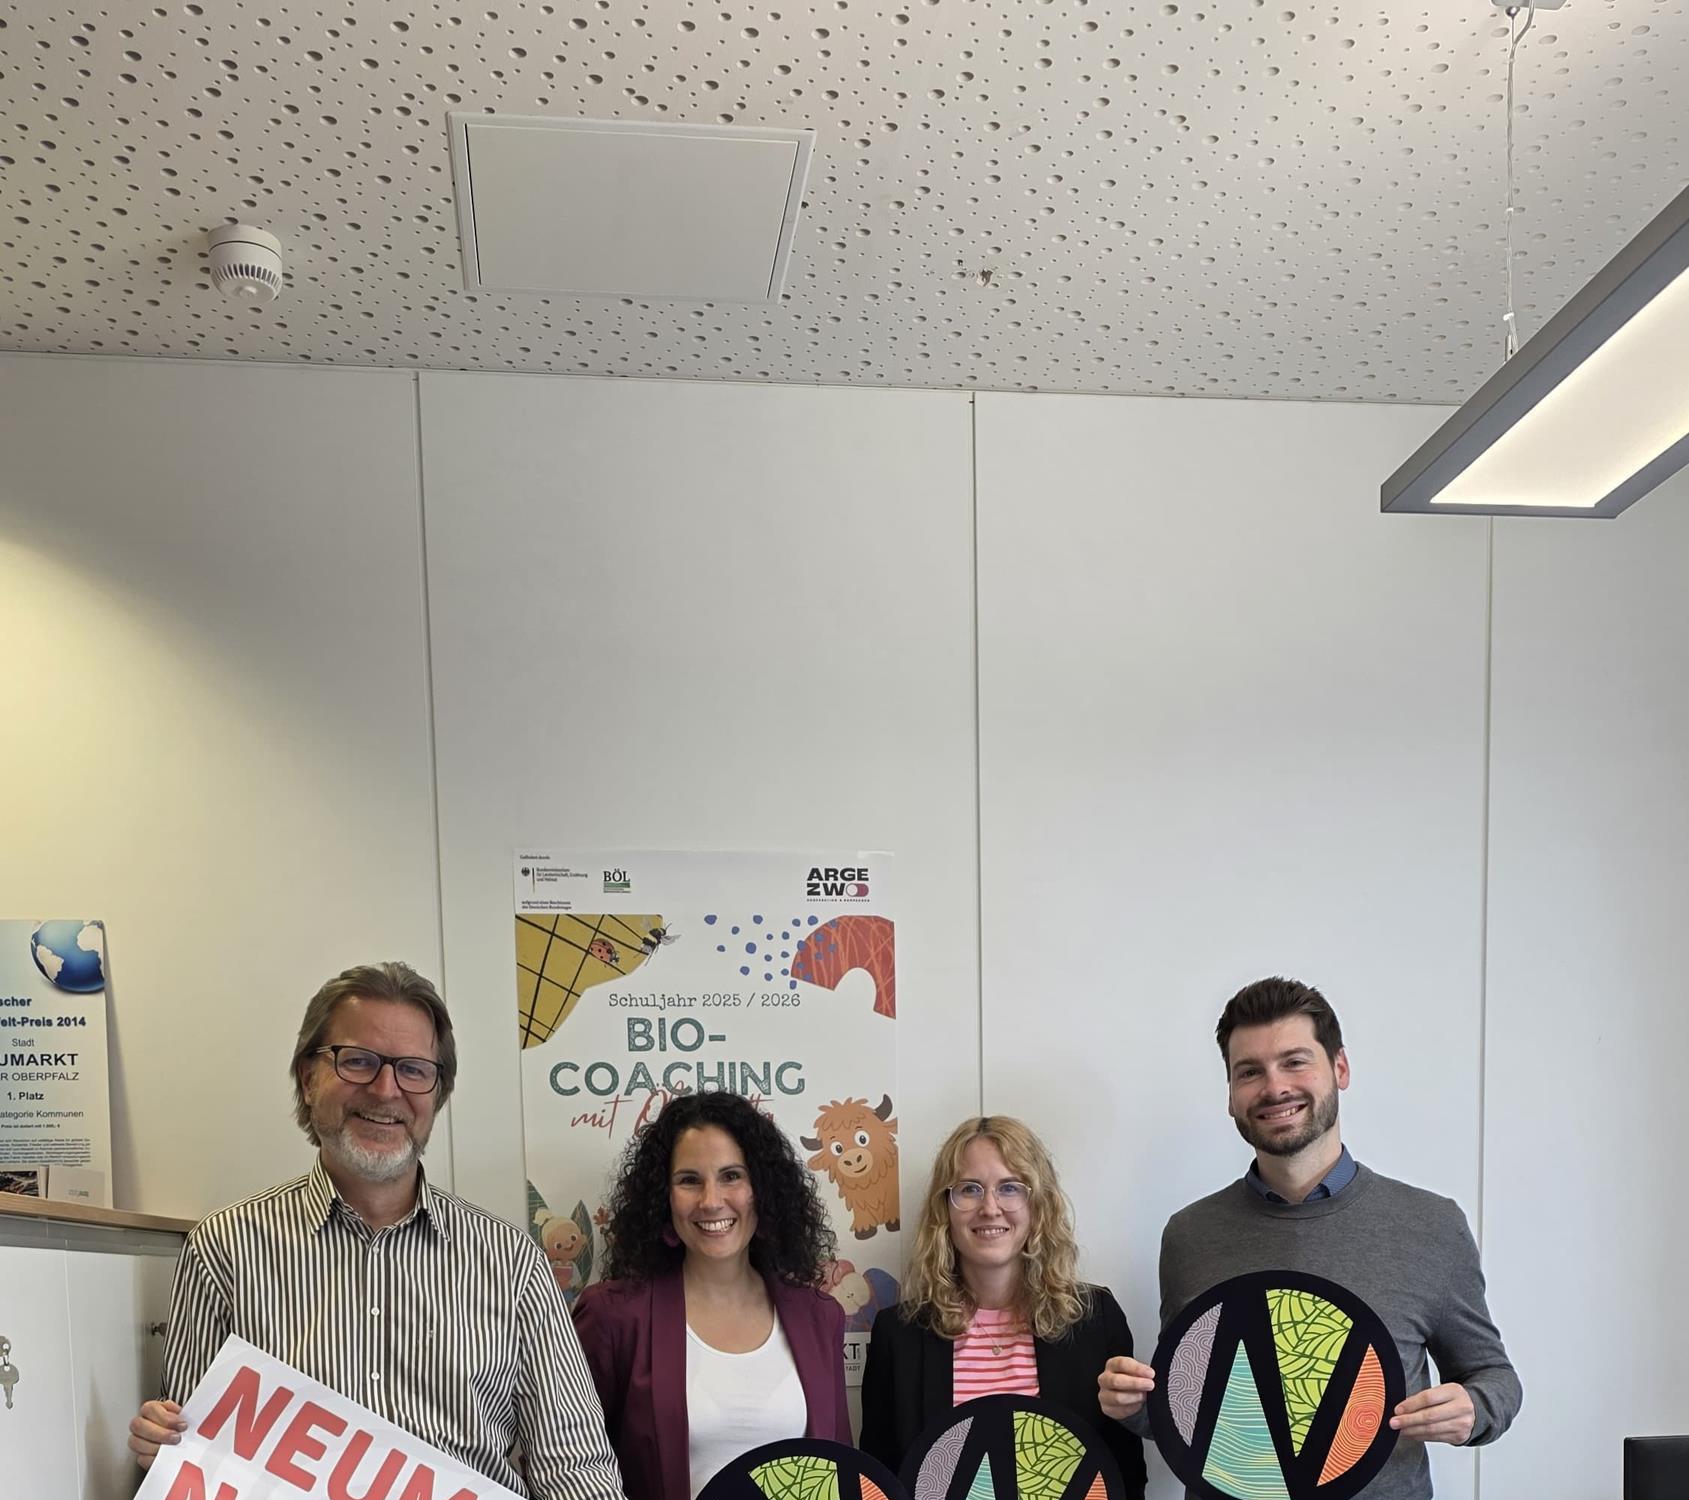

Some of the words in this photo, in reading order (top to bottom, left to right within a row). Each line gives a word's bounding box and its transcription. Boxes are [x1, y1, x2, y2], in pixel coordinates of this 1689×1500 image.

[603, 868, 631, 882] BÖL
[806, 867, 869, 881] ARGE
[609, 993, 697, 1010] Schuljahr
[702, 993, 742, 1007] 2025
[761, 993, 801, 1007] 2026
[0, 1016, 53, 1027] elt-Preis
[56, 1016, 87, 1027] 2014
[627, 1017, 727, 1052] BIO-
[11, 1038, 35, 1047] Stadt
[0, 1053, 79, 1067] UMARKT
[12, 1071, 80, 1081] OBERPFALZ
[549, 1061, 806, 1096] COACHING
[7, 1091, 16, 1101] 1.
[19, 1091, 45, 1101] Platz
[36, 1110, 84, 1118] Kommunen
